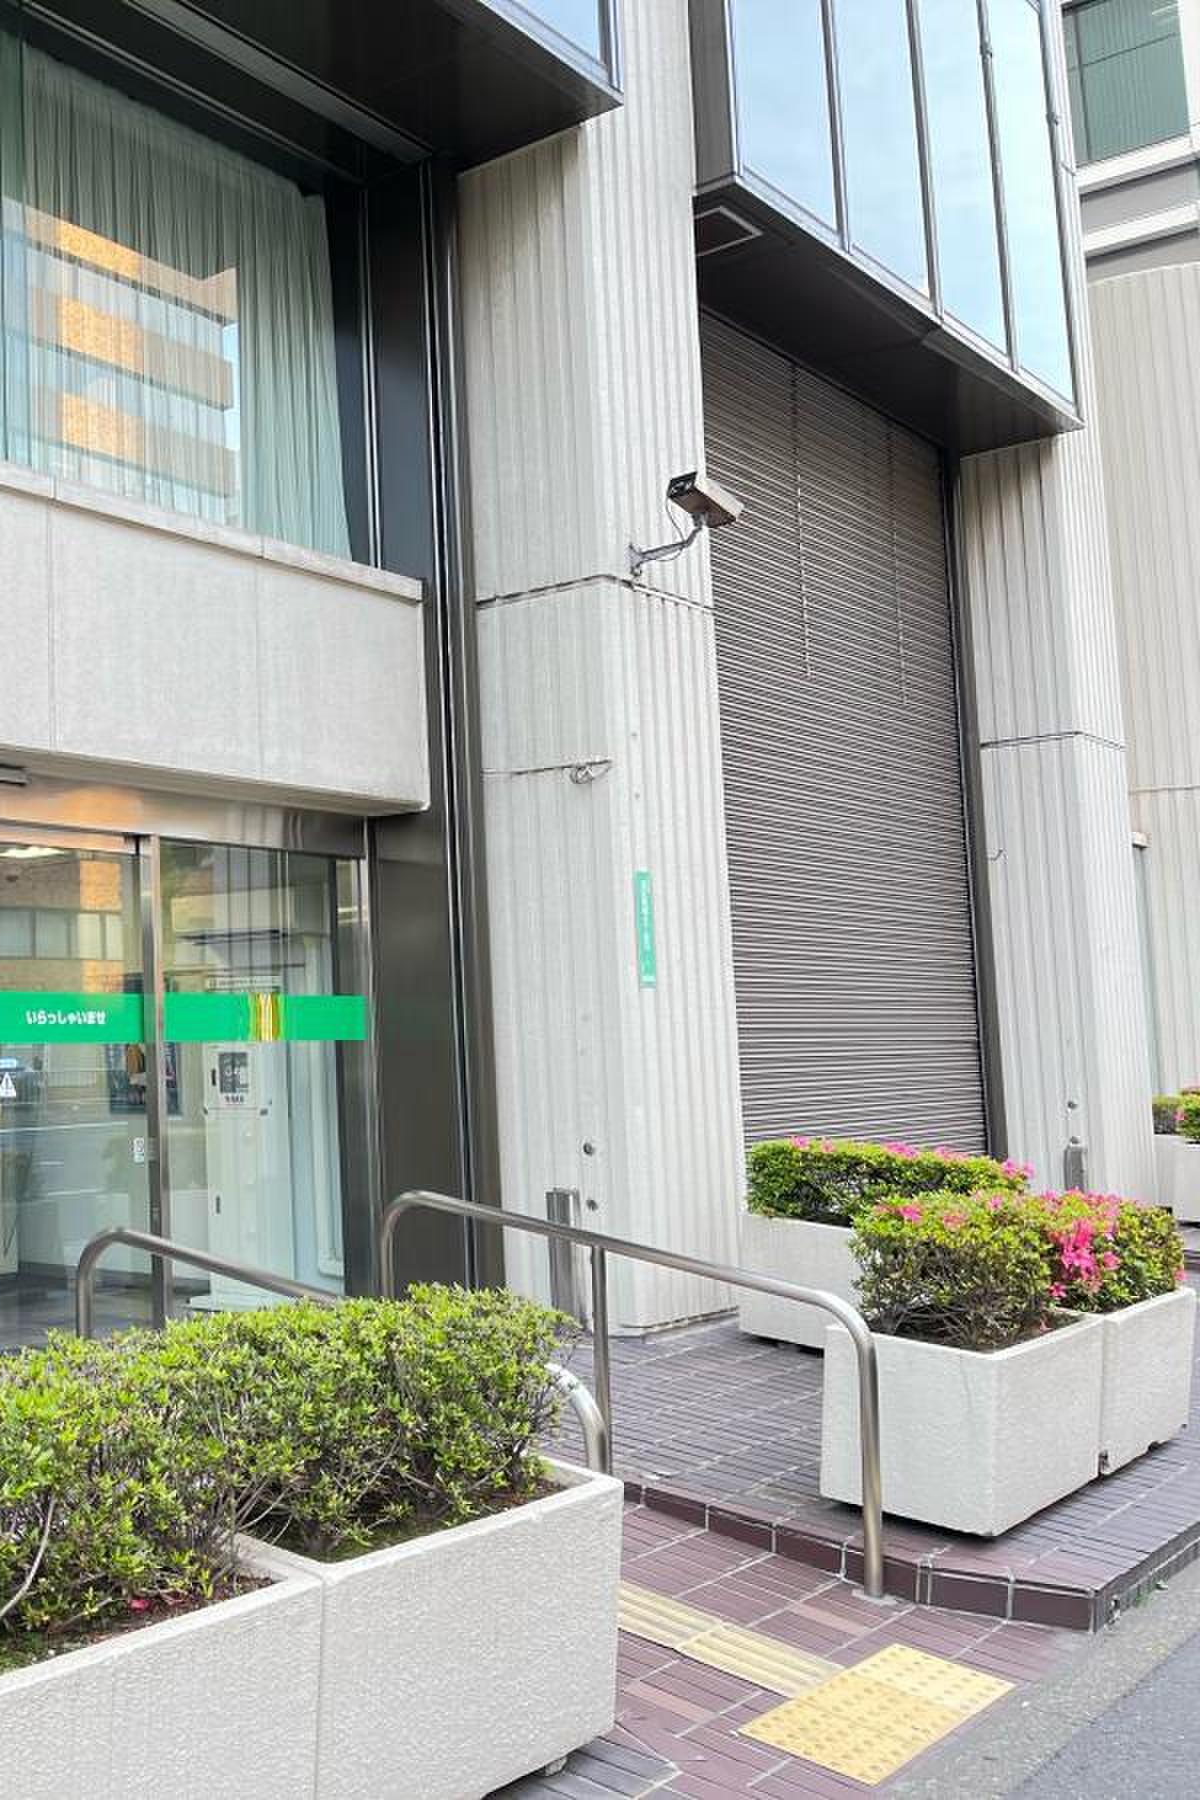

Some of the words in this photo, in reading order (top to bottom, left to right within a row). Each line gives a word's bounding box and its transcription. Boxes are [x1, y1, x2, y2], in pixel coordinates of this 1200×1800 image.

[25, 1010, 107, 1025] いらっしゃいませ
